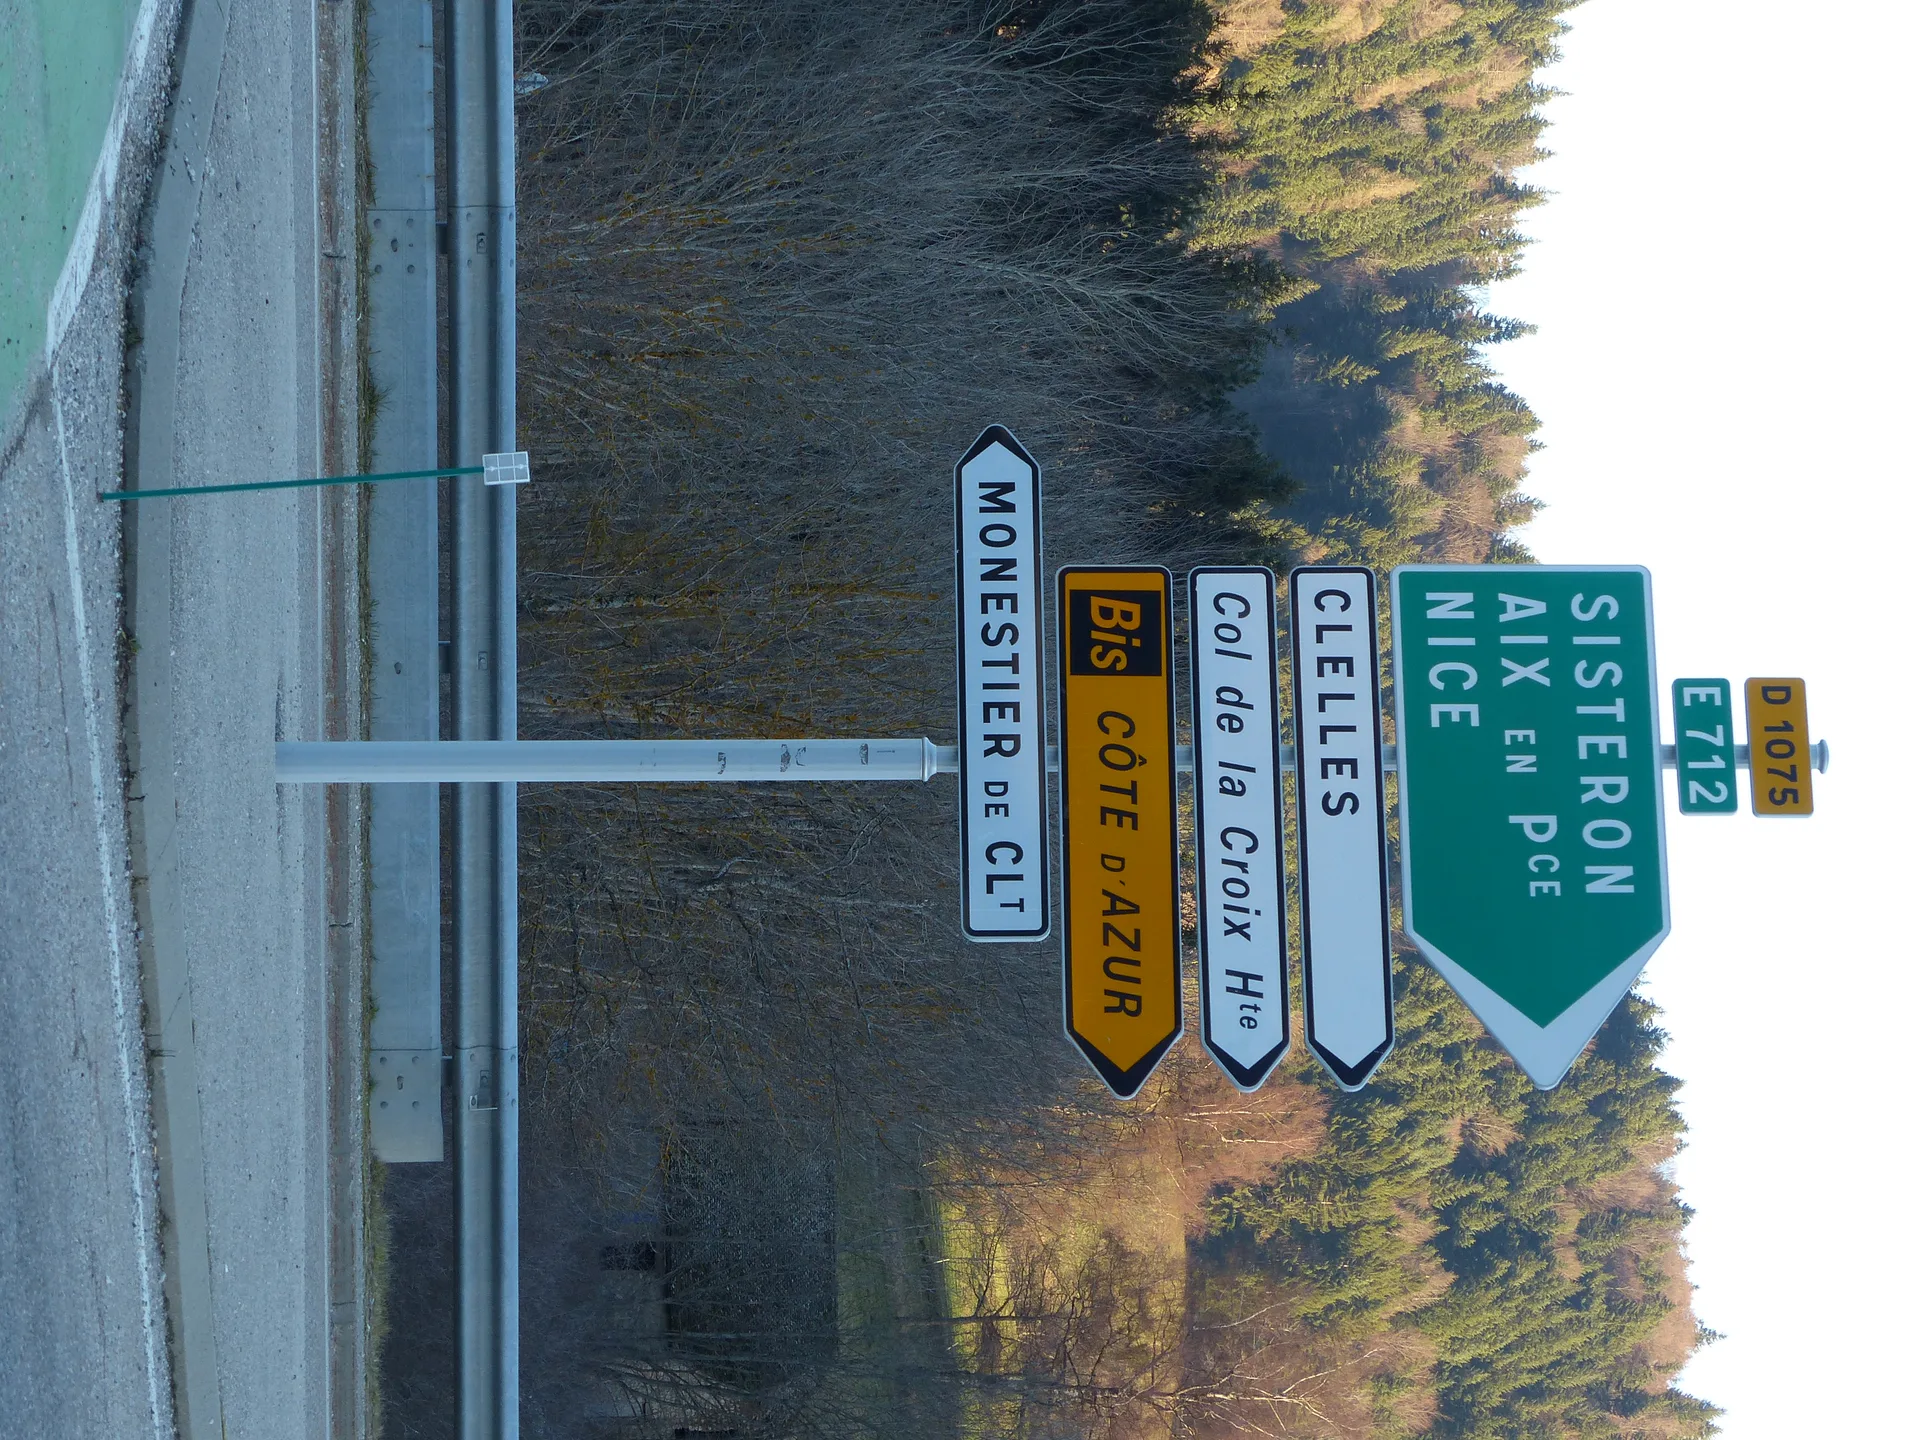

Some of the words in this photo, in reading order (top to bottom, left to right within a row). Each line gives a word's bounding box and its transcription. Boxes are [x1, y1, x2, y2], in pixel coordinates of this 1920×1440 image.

[978, 481, 1021, 758] MONESTIER
[1090, 595, 1141, 671] Bis
[1212, 592, 1253, 661] Col
[1497, 592, 1551, 688] AIX
[1425, 592, 1480, 728] NICE
[1682, 686, 1722, 707] E
[1761, 685, 1792, 705] D
[1215, 685, 1254, 734] de
[1313, 589, 1360, 817] CLELLES
[1570, 592, 1635, 894] SISTERON
[1097, 710, 1148, 831] CÔTE
[1218, 760, 1257, 797] la
[1504, 729, 1538, 773] EN
[1685, 724, 1729, 804] 712
[1763, 720, 1800, 806] 1075
[983, 781, 1010, 818] DE
[1220, 826, 1261, 942] Croix
